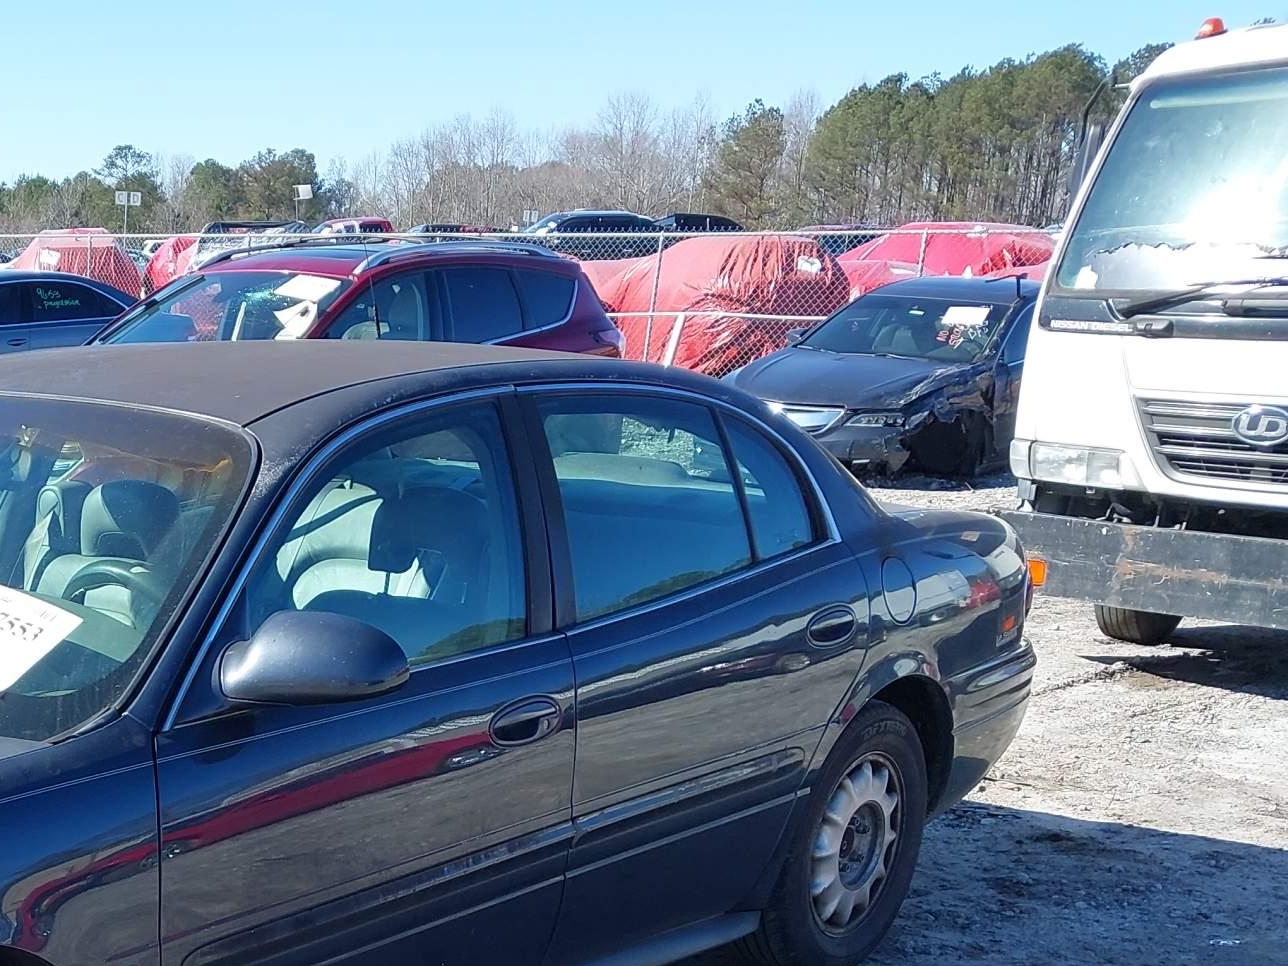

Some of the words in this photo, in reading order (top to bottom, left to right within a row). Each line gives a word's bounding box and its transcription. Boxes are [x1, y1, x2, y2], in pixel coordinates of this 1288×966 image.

[1050, 319, 1088, 330] NISSAN
[1091, 321, 1133, 332] DIESEL
[1238, 413, 1288, 437] UD
